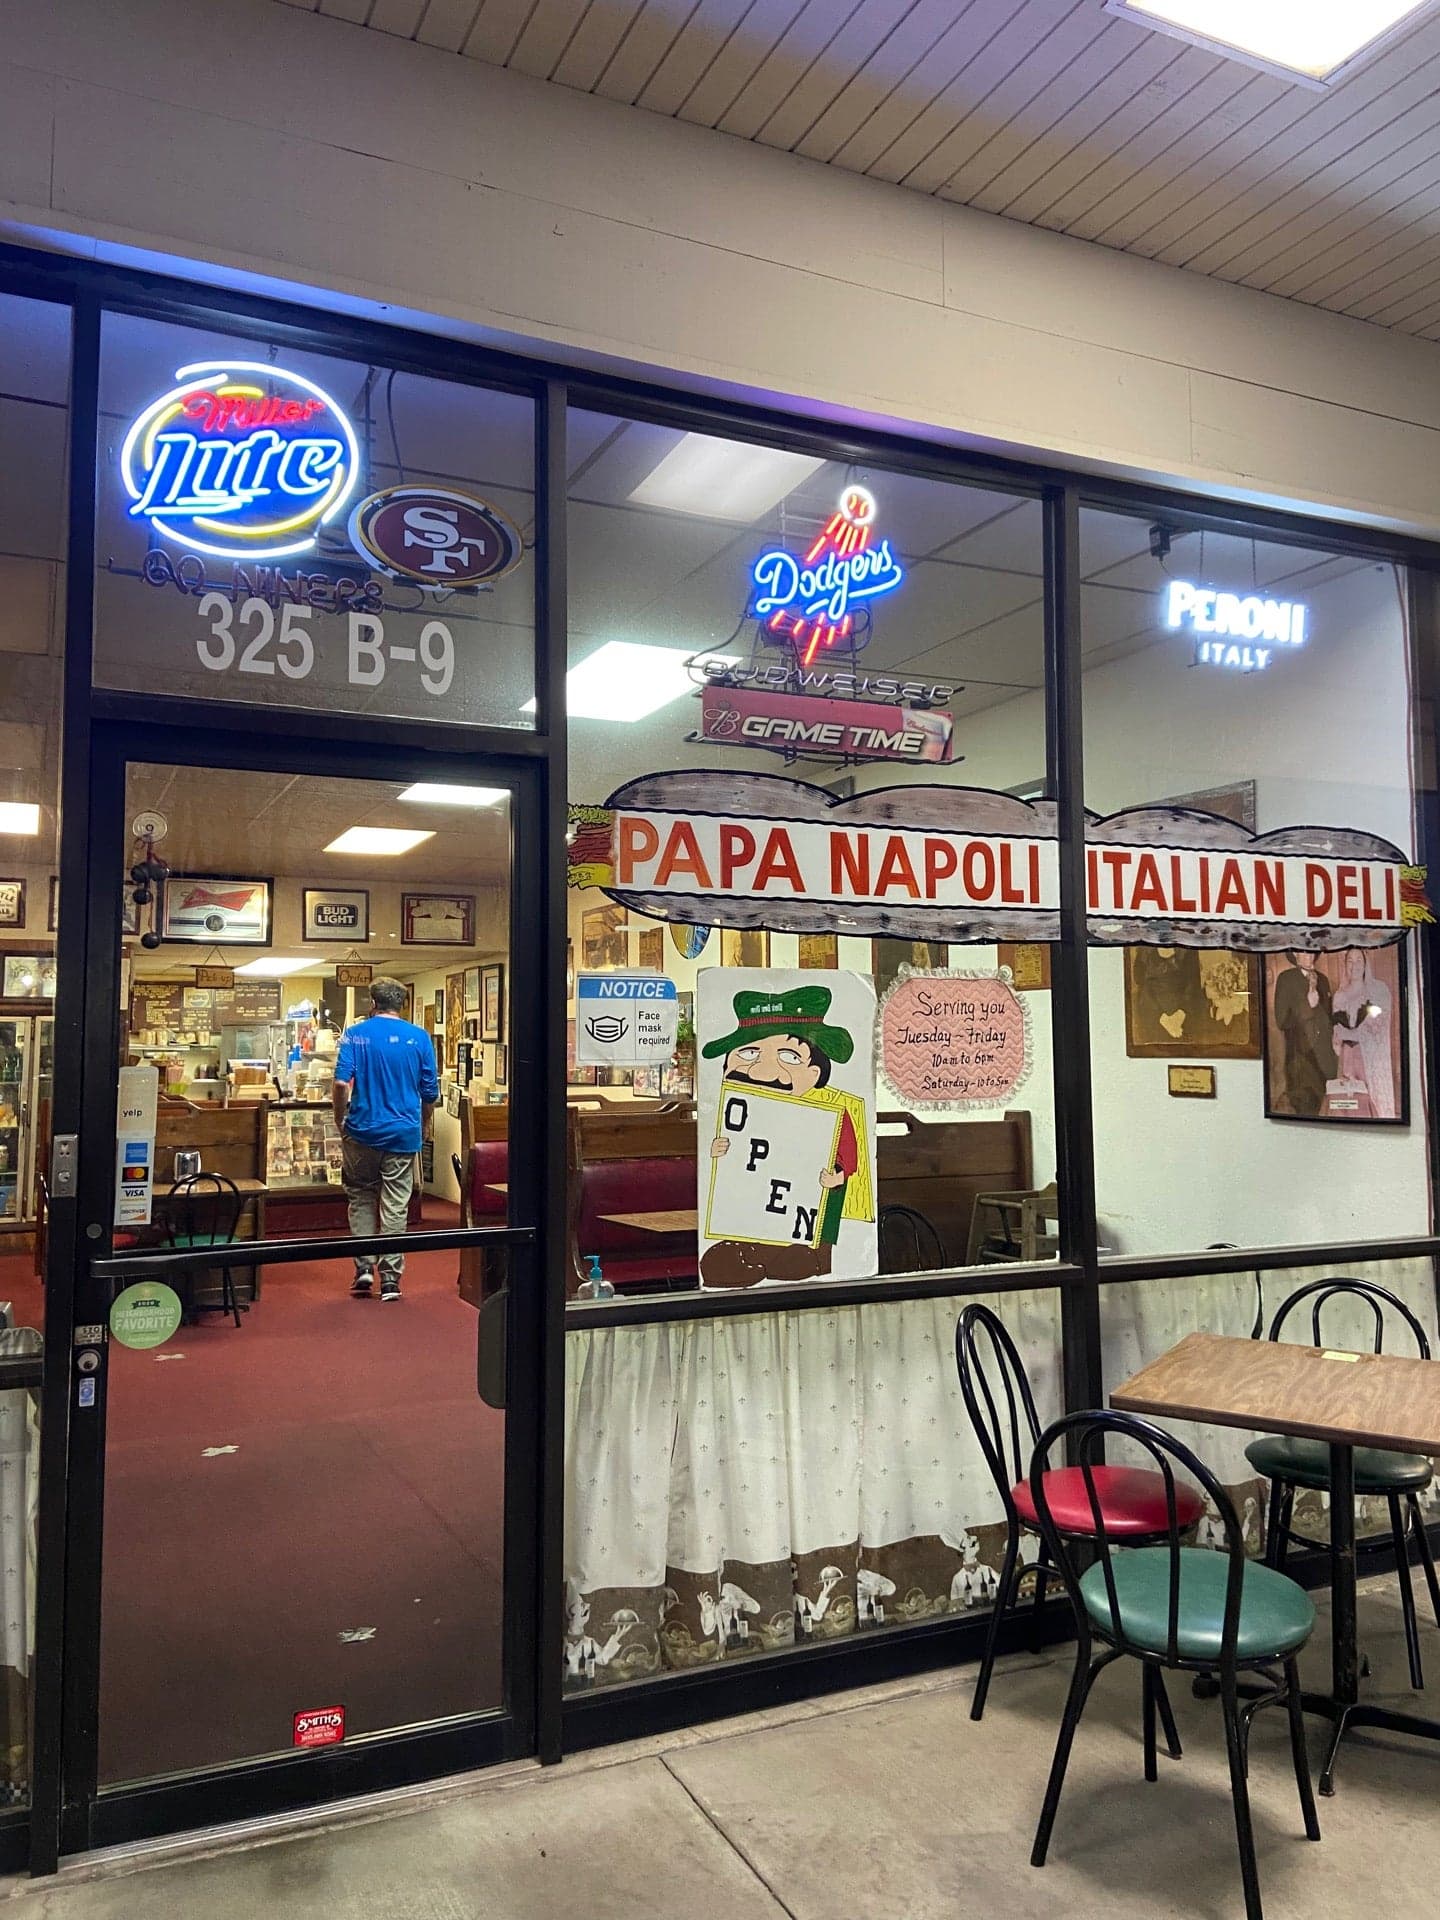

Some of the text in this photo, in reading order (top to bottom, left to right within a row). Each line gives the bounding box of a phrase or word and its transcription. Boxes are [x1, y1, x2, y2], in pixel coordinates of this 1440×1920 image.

[181, 392, 326, 431] Miller
[130, 430, 343, 515] Lite
[755, 541, 902, 620] Dodgers
[1167, 580, 1307, 643] PERONI
[196, 592, 455, 695] 325 B-9
[1202, 643, 1270, 669] ITALY
[741, 716, 845, 746] GAME
[848, 728, 925, 753] TIME
[619, 816, 1396, 921] PAPA NAPOLI ITALIAN DELI
[323, 906, 350, 915] BUD
[317, 914, 355, 924] LIGHT
[339, 970, 371, 983] Order
[599, 982, 665, 997] NOTICE
[912, 992, 1005, 1022] Serving you
[639, 1011, 660, 1020] Face
[639, 1024, 662, 1032] mask
[639, 1036, 670, 1046] required
[895, 1026, 951, 1048] Tuesday
[965, 1027, 1006, 1049] Friday
[974, 1053, 994, 1065] 6pm
[122, 1109, 142, 1117] yelp
[125, 1189, 145, 1197] VISA
[115, 1316, 174, 1331] FAVORITE
